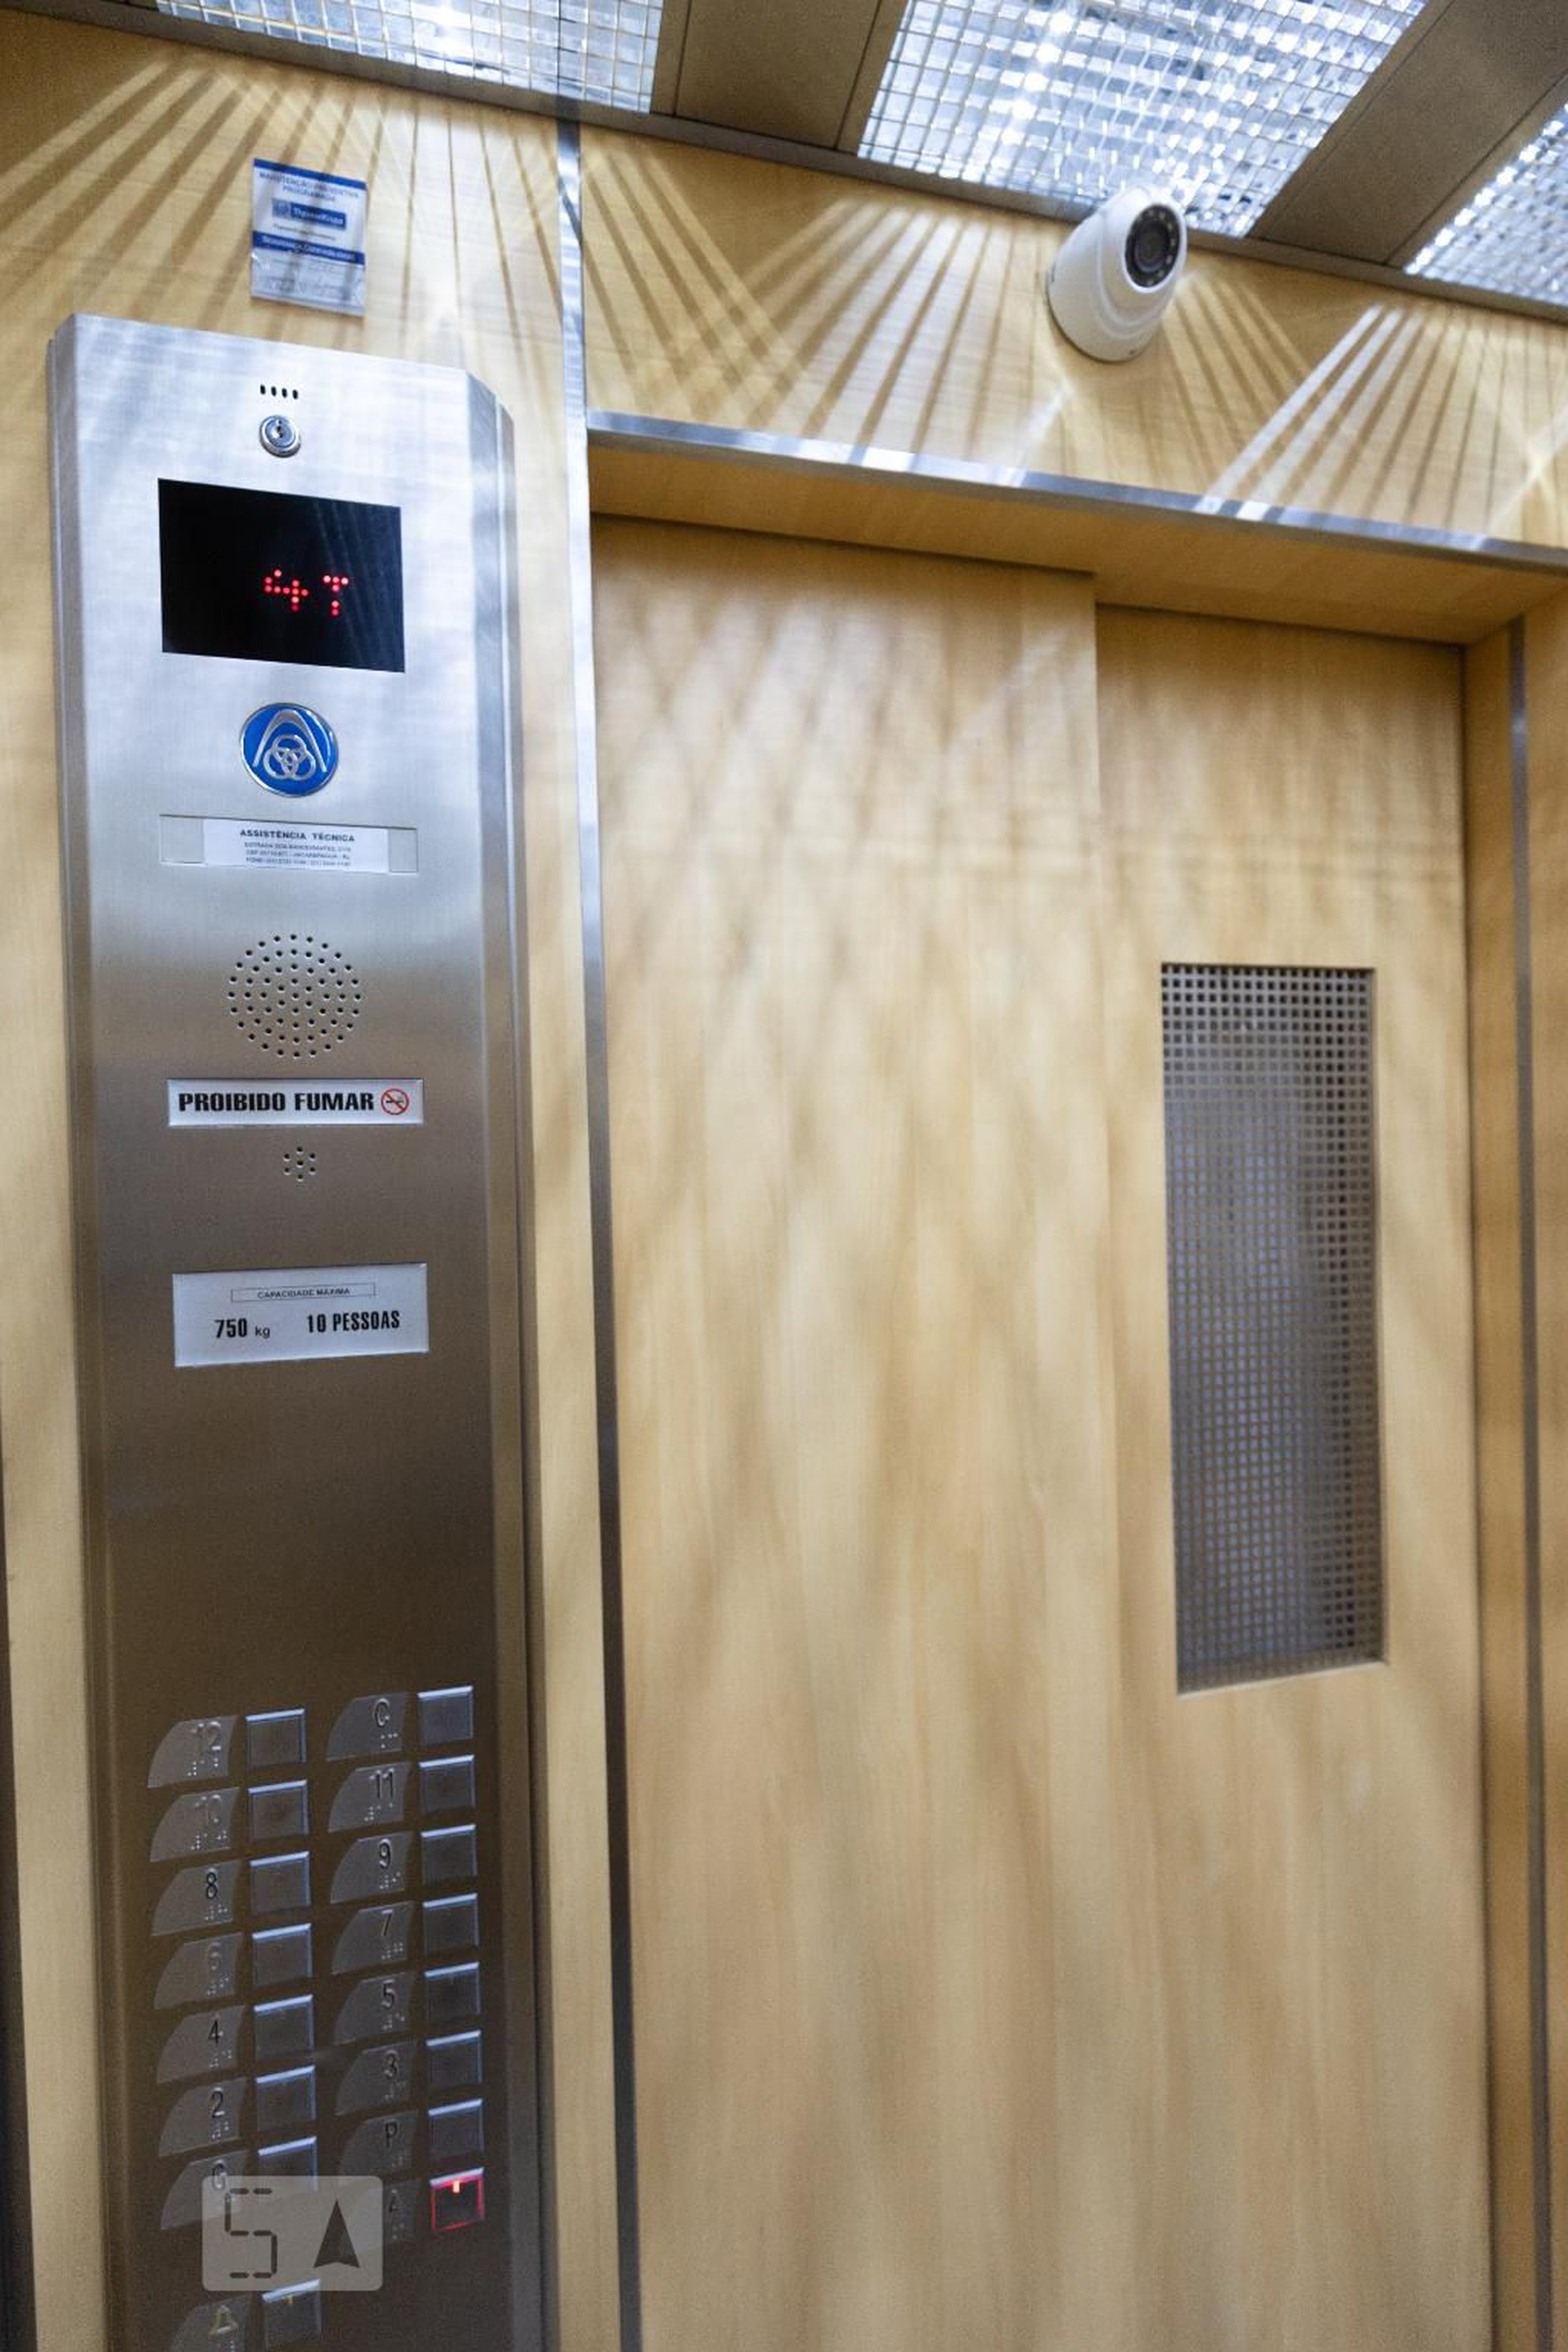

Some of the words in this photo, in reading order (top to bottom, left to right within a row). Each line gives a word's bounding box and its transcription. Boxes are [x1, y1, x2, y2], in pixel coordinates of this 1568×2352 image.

[178, 1092, 286, 1112] PROIBIDO
[294, 1092, 374, 1111] FUMAR
[257, 1290, 314, 1299] CAPACIDADE
[215, 1318, 248, 1339] 750
[255, 1325, 270, 1339] kg
[307, 1314, 326, 1333] 10
[332, 1310, 400, 1332] PESSOAS
[370, 1767, 395, 1799] 11
[379, 1838, 392, 1869] 9
[206, 1867, 218, 1900] 8
[380, 1909, 394, 1936] 7
[381, 1979, 396, 2009] 5
[208, 2013, 223, 2045] 4
[383, 2049, 399, 2078] 3
[210, 2086, 226, 2118] 2
[385, 2117, 399, 2147] P
